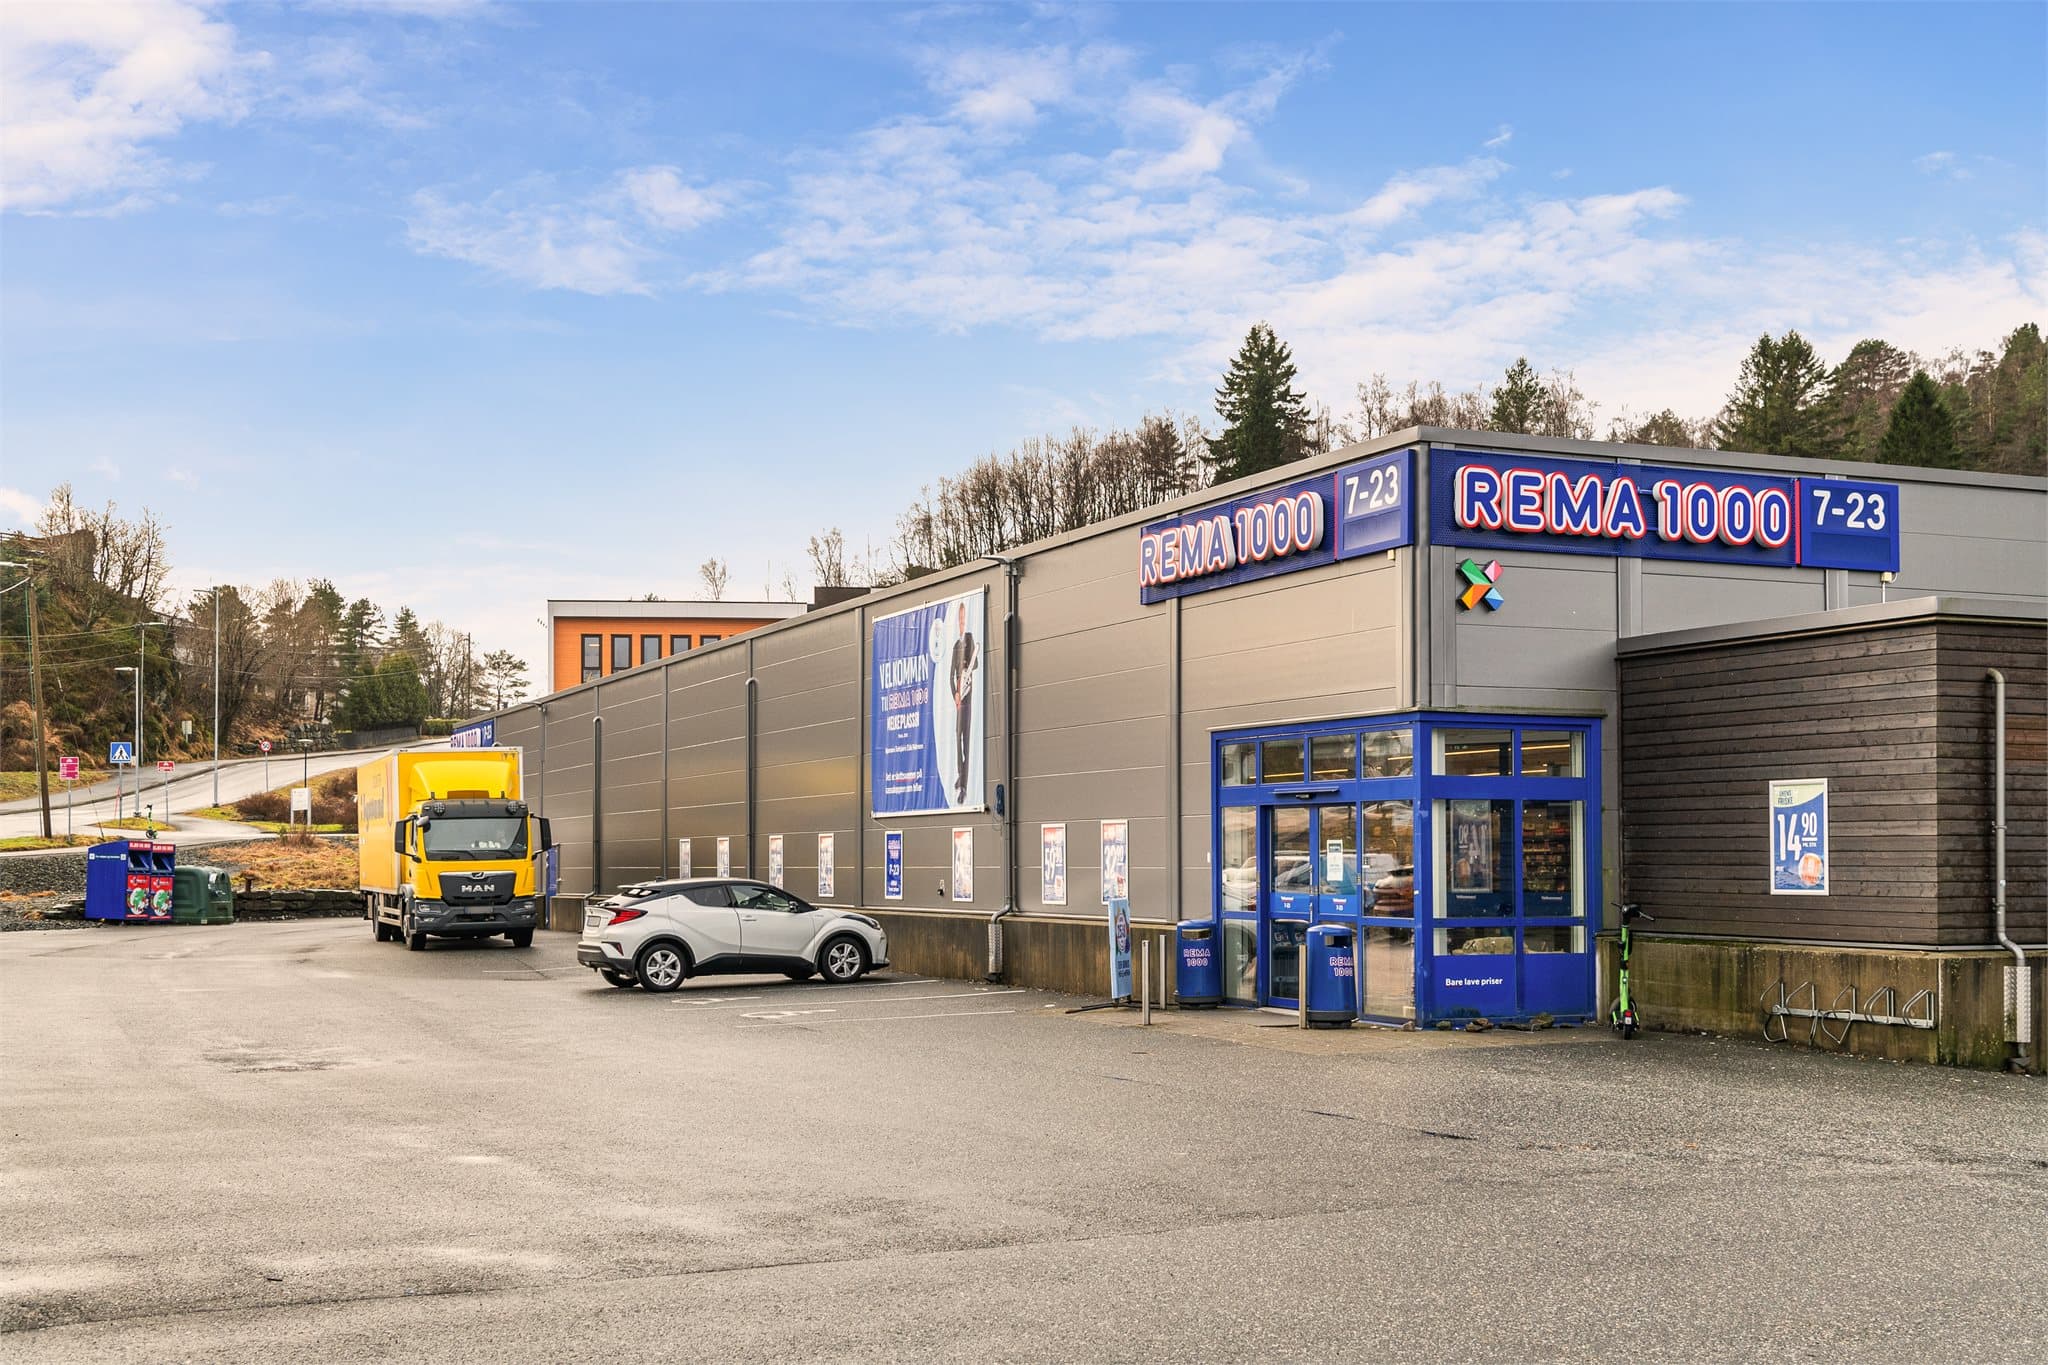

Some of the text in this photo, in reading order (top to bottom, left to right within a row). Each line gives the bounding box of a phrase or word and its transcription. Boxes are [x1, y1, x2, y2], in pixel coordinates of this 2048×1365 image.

[1345, 465, 1399, 515] 7-23
[1454, 464, 1791, 549] REMA 1000
[1813, 489, 1886, 531] 7-23
[1139, 491, 1324, 588] REMA 1000
[880, 653, 929, 690] VELKOMMEN
[1777, 812, 1818, 861] 14 90
[461, 884, 495, 893] MAN
[1183, 949, 1210, 957] REMA
[1186, 958, 1208, 967] 1000
[1445, 977, 1503, 988] Bare lave priser
